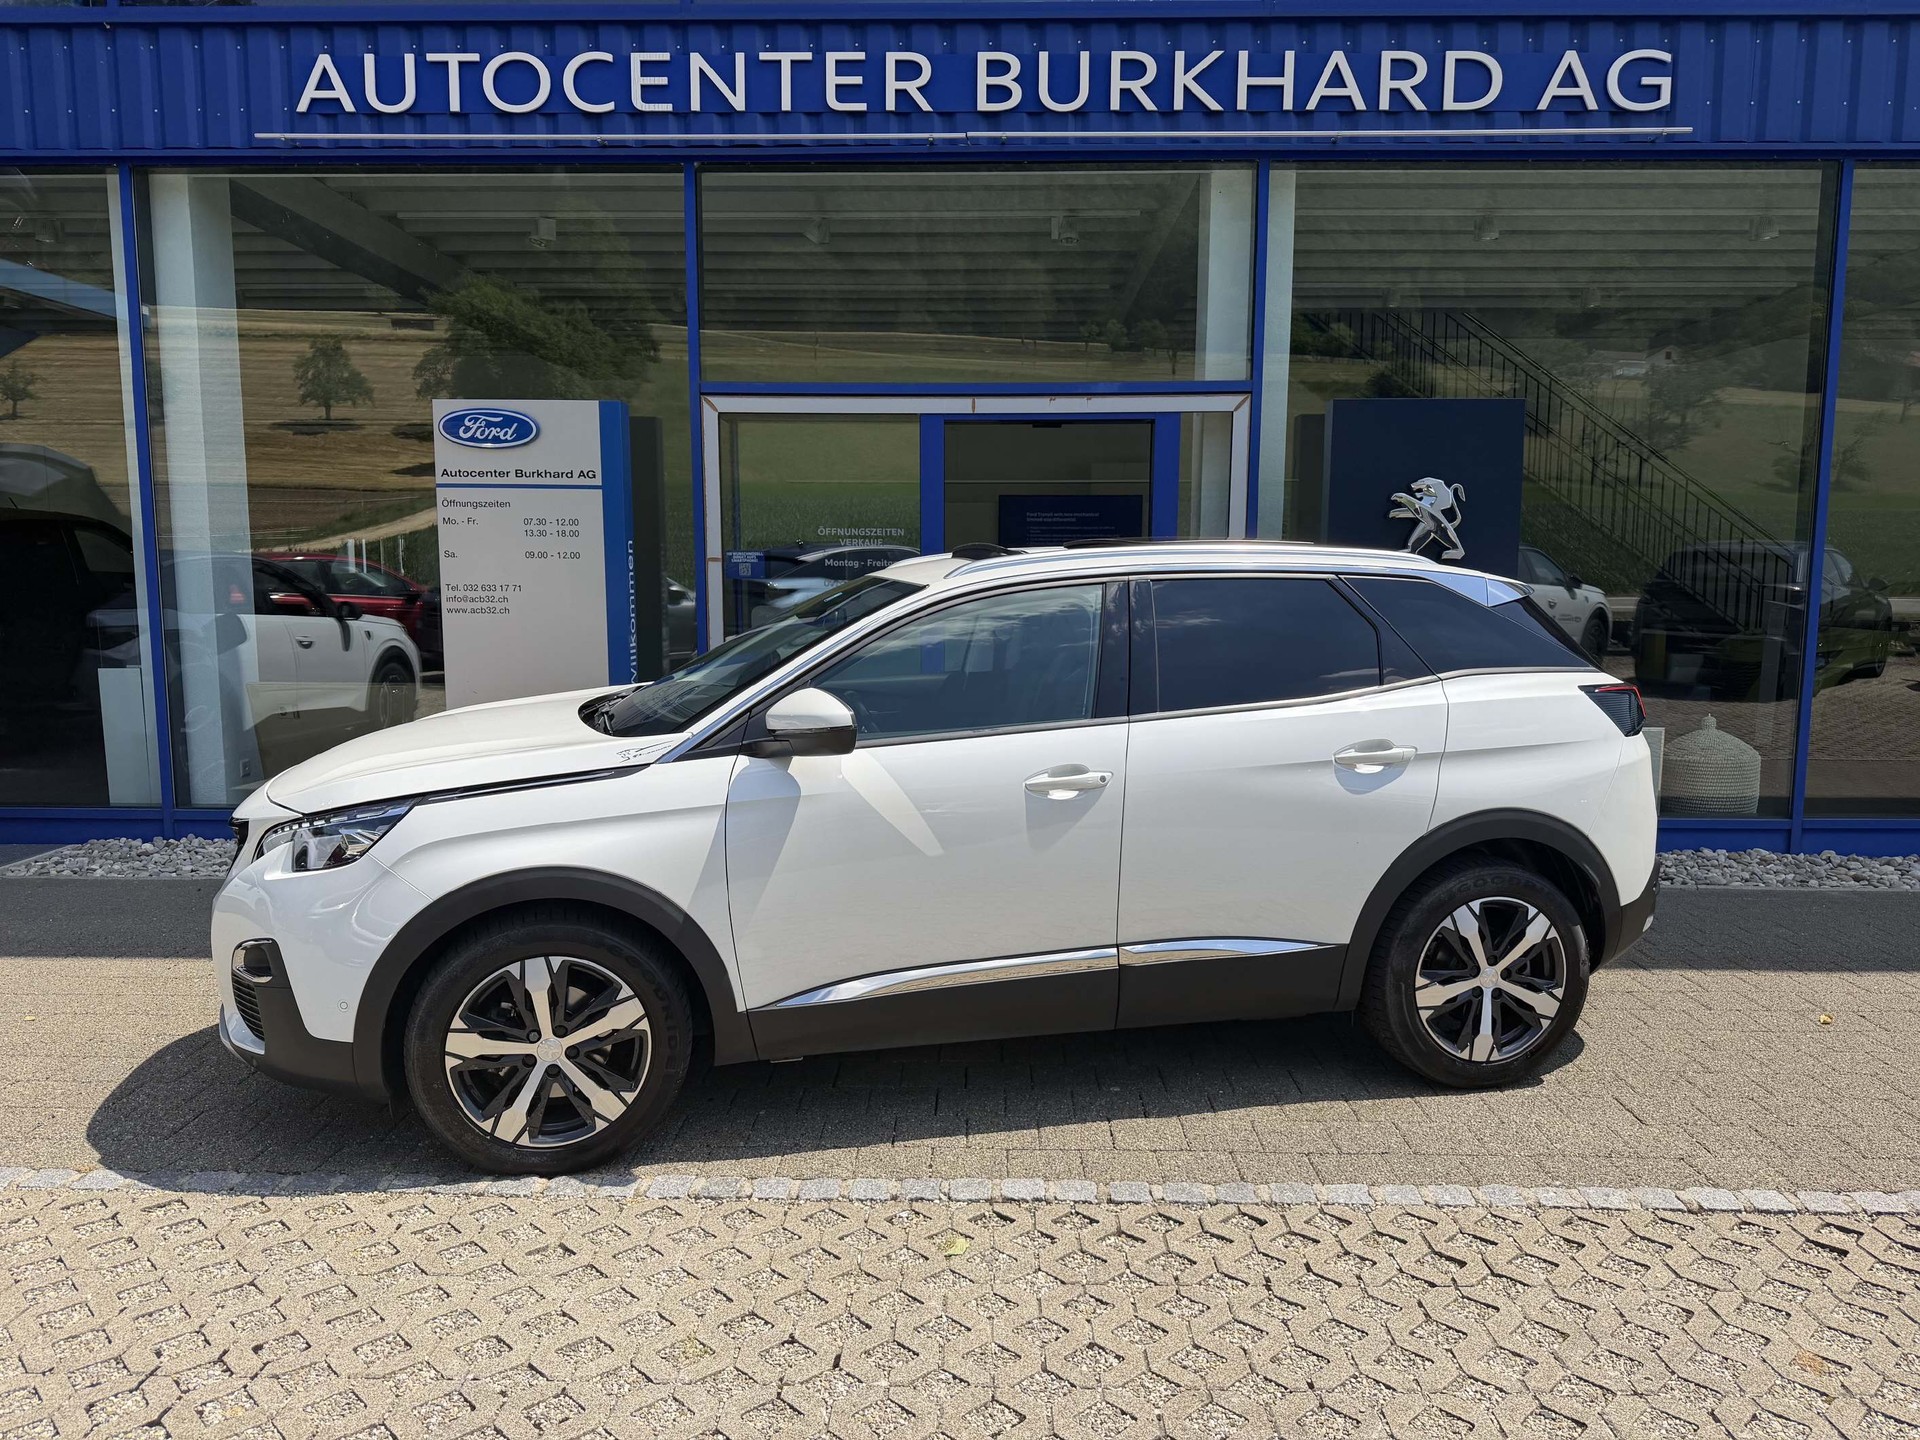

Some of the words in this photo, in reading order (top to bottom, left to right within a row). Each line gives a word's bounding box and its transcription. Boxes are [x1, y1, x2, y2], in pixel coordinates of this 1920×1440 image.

[295, 51, 934, 113] AUTOCENTER
[976, 49, 1503, 112] BURKHARD
[1536, 48, 1673, 112] AG
[459, 414, 518, 440] Ford
[441, 468, 511, 478] Autocenter
[514, 469, 574, 479] Burkhard
[577, 470, 597, 479] AG
[441, 497, 511, 509] Öffnungszeiten
[442, 517, 459, 525] Mo.
[467, 517, 479, 525] Fr.
[523, 518, 547, 526] 07.30
[556, 518, 579, 526] 12.00
[524, 529, 547, 537] 13.30
[556, 529, 580, 537] 18.00
[817, 526, 905, 536] ÖFFNUNGSZEITEN
[839, 538, 883, 547] VERKAUF
[443, 550, 458, 558] Sa.
[525, 551, 548, 559] 09.00
[557, 551, 581, 559] 12.00
[825, 559, 859, 568] Montag
[445, 583, 461, 592] Tel.
[463, 584, 479, 592] 032
[481, 584, 497, 592] 633
[499, 584, 510, 592] 17
[512, 584, 522, 592] 71
[445, 595, 509, 603] info@acb32.ch
[446, 606, 510, 615] www.acb32.ch
